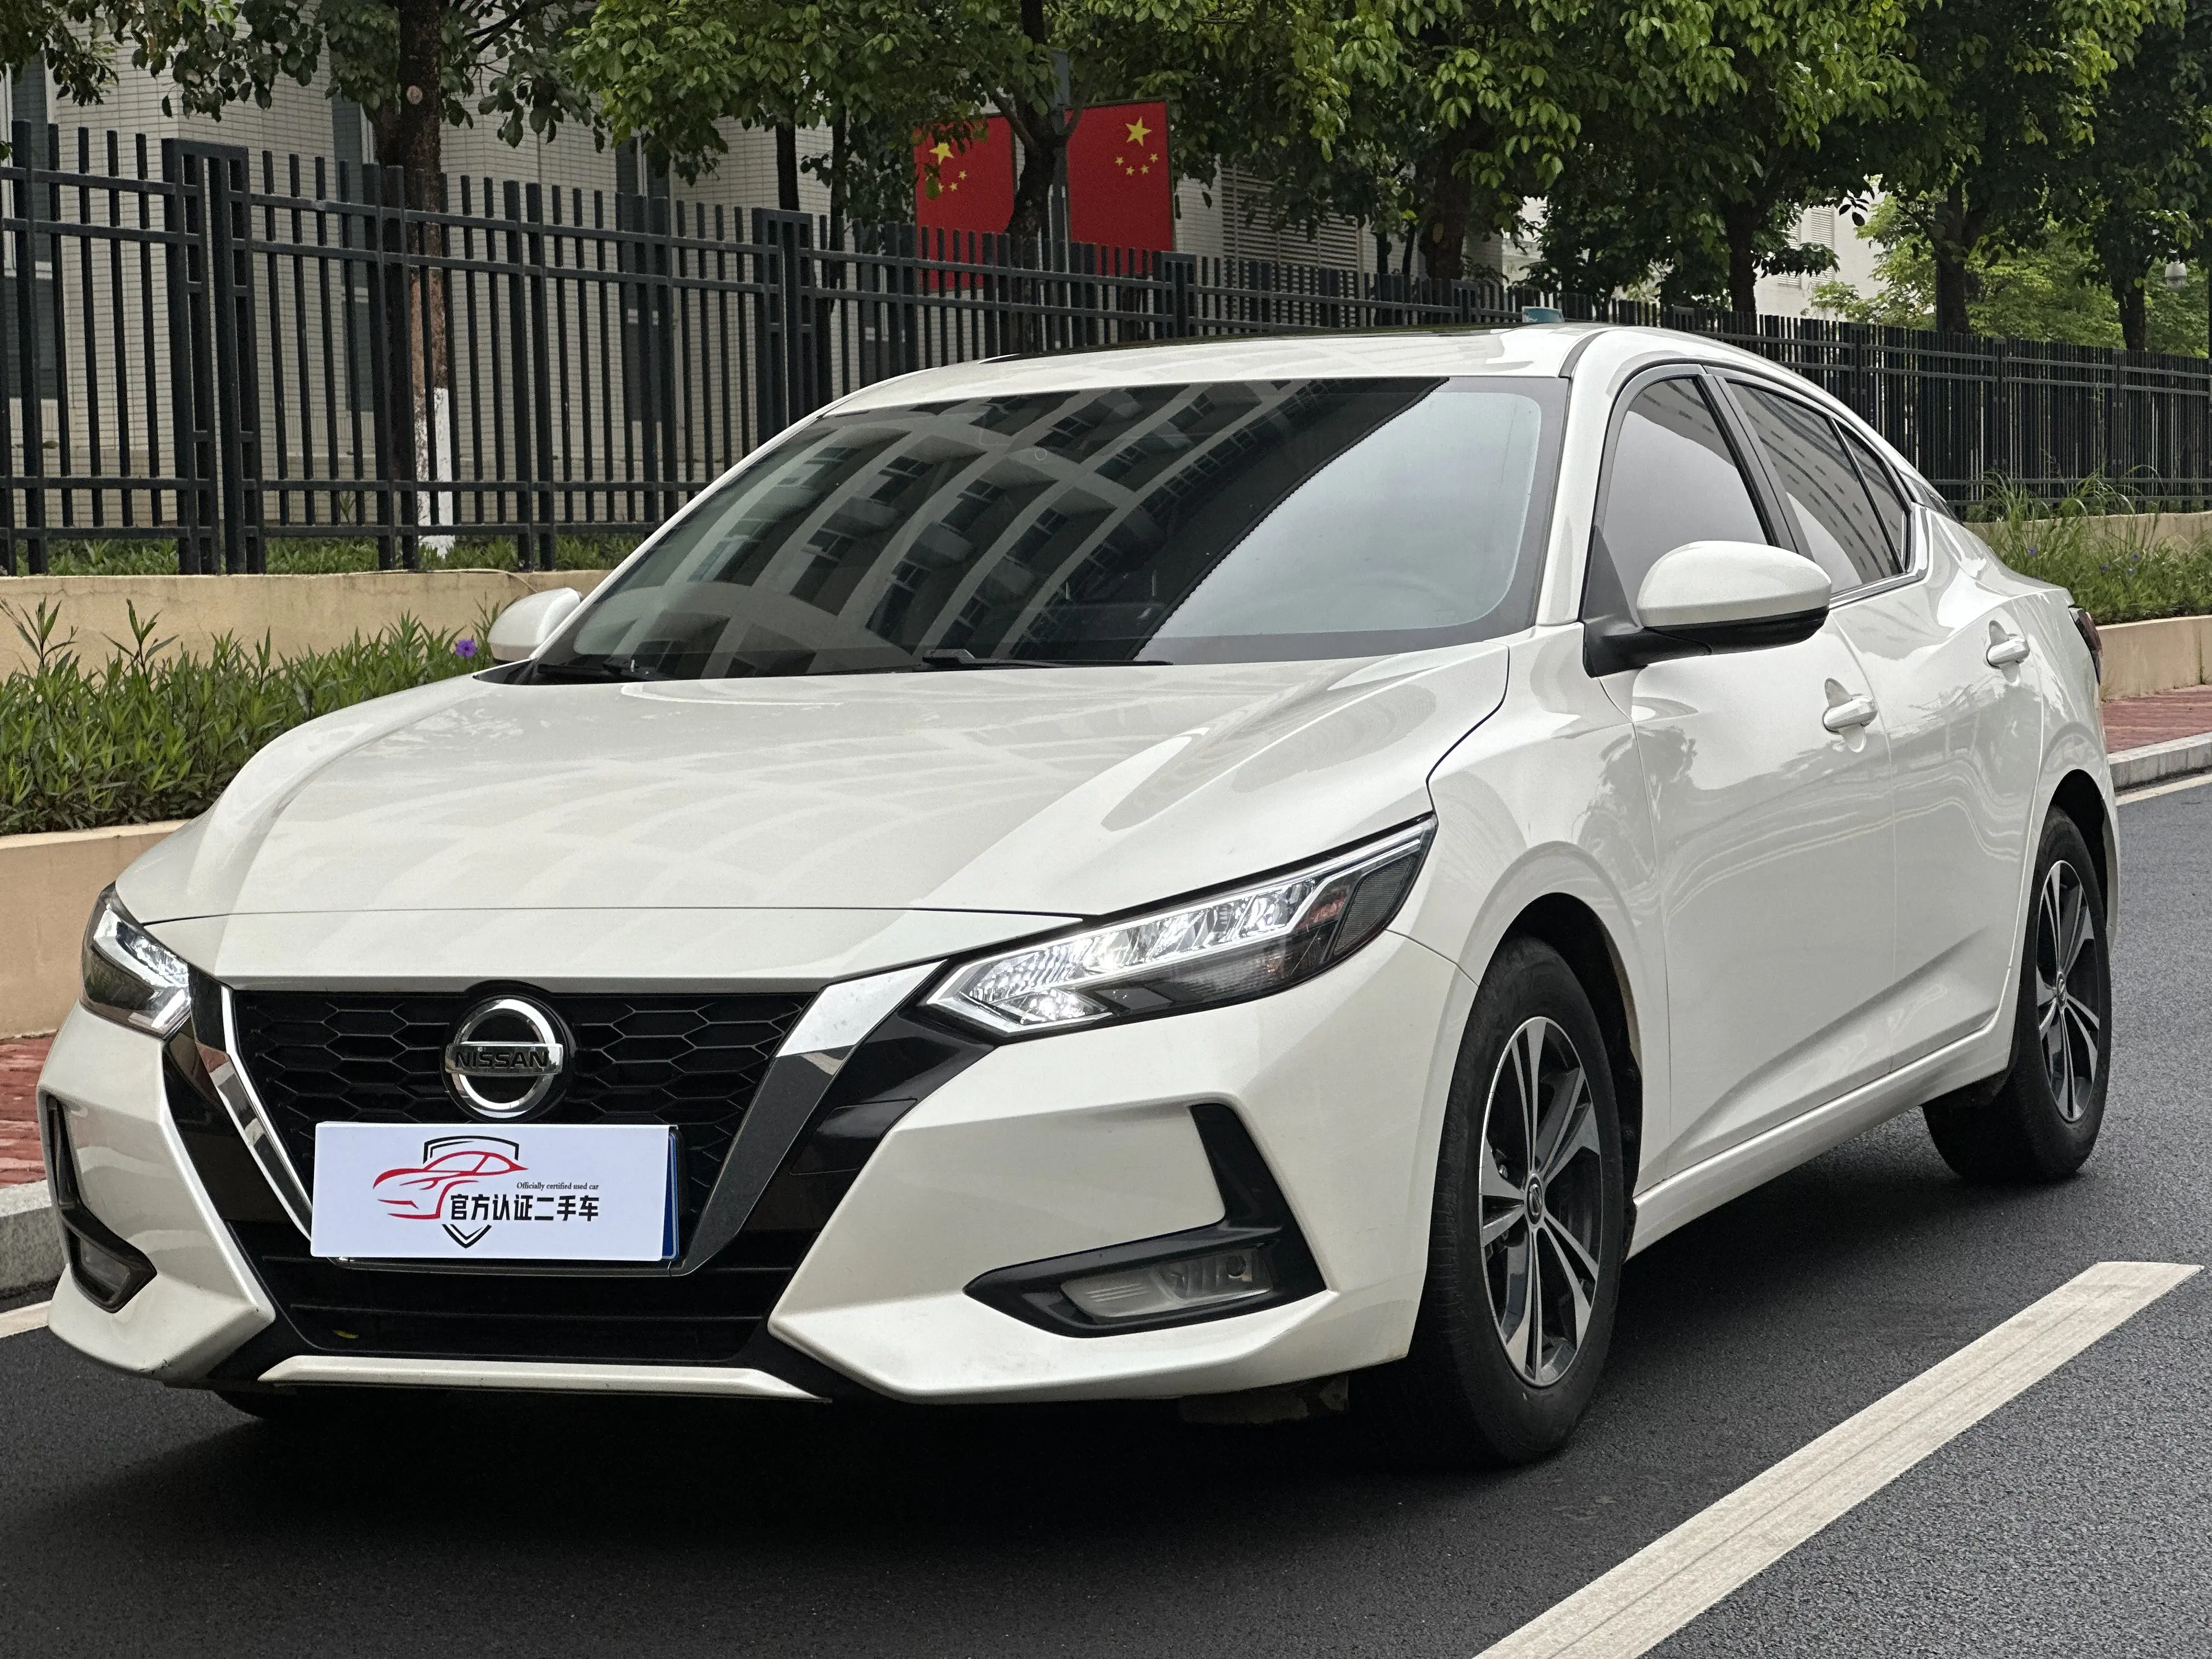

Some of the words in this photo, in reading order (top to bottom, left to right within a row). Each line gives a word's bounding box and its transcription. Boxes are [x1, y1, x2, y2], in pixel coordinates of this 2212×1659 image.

[455, 1051, 548, 1068] NISSAN
[517, 1182, 545, 1191] Officially
[450, 1194, 599, 1221] 官方认证二手车
